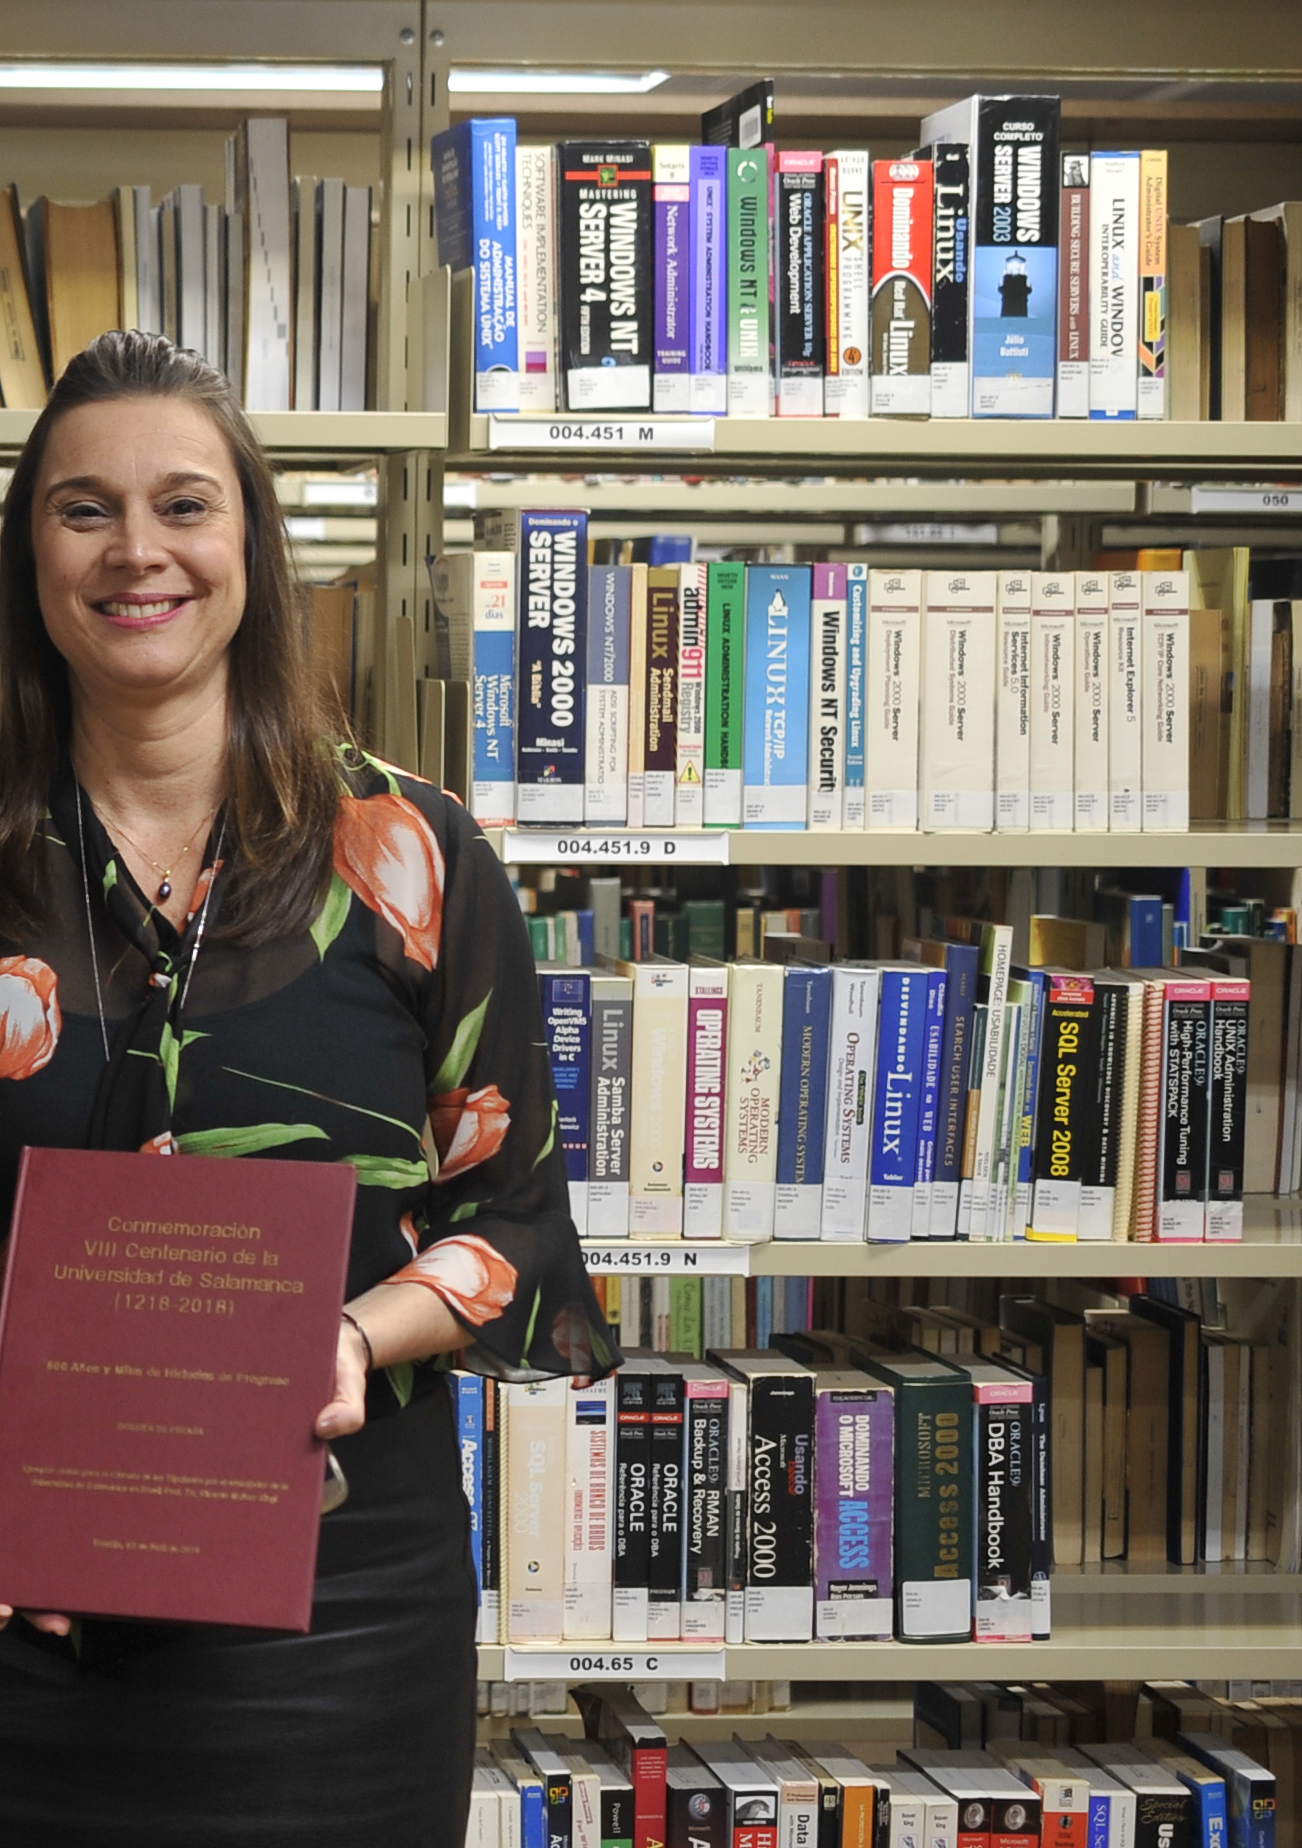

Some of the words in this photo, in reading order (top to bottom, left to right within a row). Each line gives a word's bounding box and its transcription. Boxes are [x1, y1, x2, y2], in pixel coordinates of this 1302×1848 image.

[993, 132, 1043, 142] COMPLETO
[1002, 122, 1035, 131] CURSO
[521, 153, 532, 230] TECHNIQUES
[534, 152, 546, 219] SOFTWARE
[579, 188, 637, 200] MASTERING
[993, 144, 1013, 203] SERVER
[1016, 144, 1042, 243] WINDOWS
[1153, 176, 1163, 206] Digital
[789, 192, 802, 224] Web
[841, 189, 864, 253] UNIX
[891, 187, 915, 269] Dominando
[935, 184, 965, 284] Linux
[992, 206, 1012, 243] 2003
[1070, 194, 1082, 238] BUILDING
[1110, 197, 1126, 250] LINUX
[579, 202, 607, 284] SERVER
[609, 201, 638, 316] WINDOWS
[789, 226, 802, 315] Development
[803, 234, 812, 301] APPLICATION
[954, 217, 968, 284] Usando
[536, 223, 548, 333] IMPLEMENTATION
[579, 287, 607, 303] 4
[610, 320, 638, 355] NT
[889, 320, 916, 376] Linux
[549, 426, 625, 440] 004.451
[638, 427, 655, 441] M
[1262, 494, 1289, 506] 050
[528, 530, 552, 629] SERVER
[551, 530, 577, 657] WINDOWS
[651, 592, 675, 660] Linux
[851, 584, 864, 645] Customizing
[820, 610, 841, 692] Windows
[1011, 630, 1020, 675] Services
[1020, 630, 1029, 672] Internet
[1126, 626, 1135, 668] Internet
[487, 674, 499, 736] Windows
[500, 674, 511, 727] Microsoft
[550, 660, 576, 728] 2000
[649, 667, 661, 752] Administration
[662, 667, 674, 722] Sendmail
[680, 681, 694, 734] Registry
[819, 698, 839, 720] NT
[1019, 674, 1028, 735] Information
[773, 708, 787, 760] TCP/IP
[557, 840, 651, 855] 004.451.9
[663, 841, 676, 856] D
[694, 986, 724, 995] STALLINGS
[994, 943, 1008, 1007] HOMEPAGE:
[754, 982, 763, 1033] TANENBAUM
[896, 976, 911, 1073] DESVENDANDO
[1169, 1019, 1180, 1045] with
[1225, 1019, 1237, 1052] UNIX
[602, 1008, 624, 1071] Linux
[695, 1008, 723, 1093] OPERATING
[801, 1025, 813, 1077] MODERN
[844, 1032, 861, 1106] OPERATING
[953, 1015, 965, 1064] SEARCH
[1057, 1021, 1079, 1060] SQL
[1213, 1019, 1226, 1081] Handbook
[611, 1076, 626, 1125] Samba
[949, 1065, 961, 1095] USER
[1053, 1063, 1077, 1126] Server
[1166, 1048, 1180, 1119] STATSPACK
[1177, 1020, 1194, 1125] High-Performance
[1221, 1054, 1235, 1142] Administration
[595, 1076, 611, 1176] Administration
[692, 1095, 721, 1170] SYSTEMS
[737, 1096, 750, 1154] SYSTEMS
[748, 1087, 761, 1164] OPERATING
[759, 1096, 770, 1155] MODERN
[797, 1079, 811, 1143] OPERATING
[839, 1107, 858, 1164] SYSTEMS
[881, 1070, 913, 1155] Linux
[943, 1098, 959, 1167] INTERFACES
[609, 1128, 624, 1175] Server
[1049, 1129, 1072, 1177] 2008
[1175, 1125, 1191, 1166] Tuning
[84, 1239, 117, 1258] VIII
[125, 1242, 227, 1265] Centenario
[233, 1248, 257, 1265] de
[263, 1250, 280, 1267] la
[108, 1216, 262, 1240] Conmemoración
[53, 1263, 163, 1286] Universidad
[169, 1269, 193, 1287] de
[200, 1272, 305, 1295] Salamanca
[582, 1252, 671, 1266] 004.451.9
[683, 1252, 698, 1266] N
[114, 1292, 235, 1316] (1218-2018)
[692, 1418, 707, 1470] Backup
[794, 1434, 808, 1495] Usando
[838, 1426, 853, 1498] MICROSOFT
[854, 1414, 870, 1492] DOMINANDO
[917, 1412, 932, 1498] MICROSOFT
[935, 1412, 959, 1475] 2000
[987, 1422, 1005, 1467] DBA
[617, 1462, 627, 1507] Referência
[629, 1462, 646, 1533] ORACLE
[651, 1462, 661, 1508] Referência
[662, 1462, 679, 1533] ORACLE
[753, 1434, 777, 1514] Access
[689, 1489, 707, 1554] Recovery
[705, 1489, 720, 1537] RMAN
[837, 1500, 870, 1570] ACCESS
[934, 1482, 959, 1578] Access
[986, 1470, 1005, 1570] Handbook
[753, 1521, 777, 1578] 2000
[569, 1656, 634, 1671] 004.65
[644, 1656, 660, 1671] C
[612, 1802, 622, 1835] Powell
[796, 1813, 811, 1845] Data
